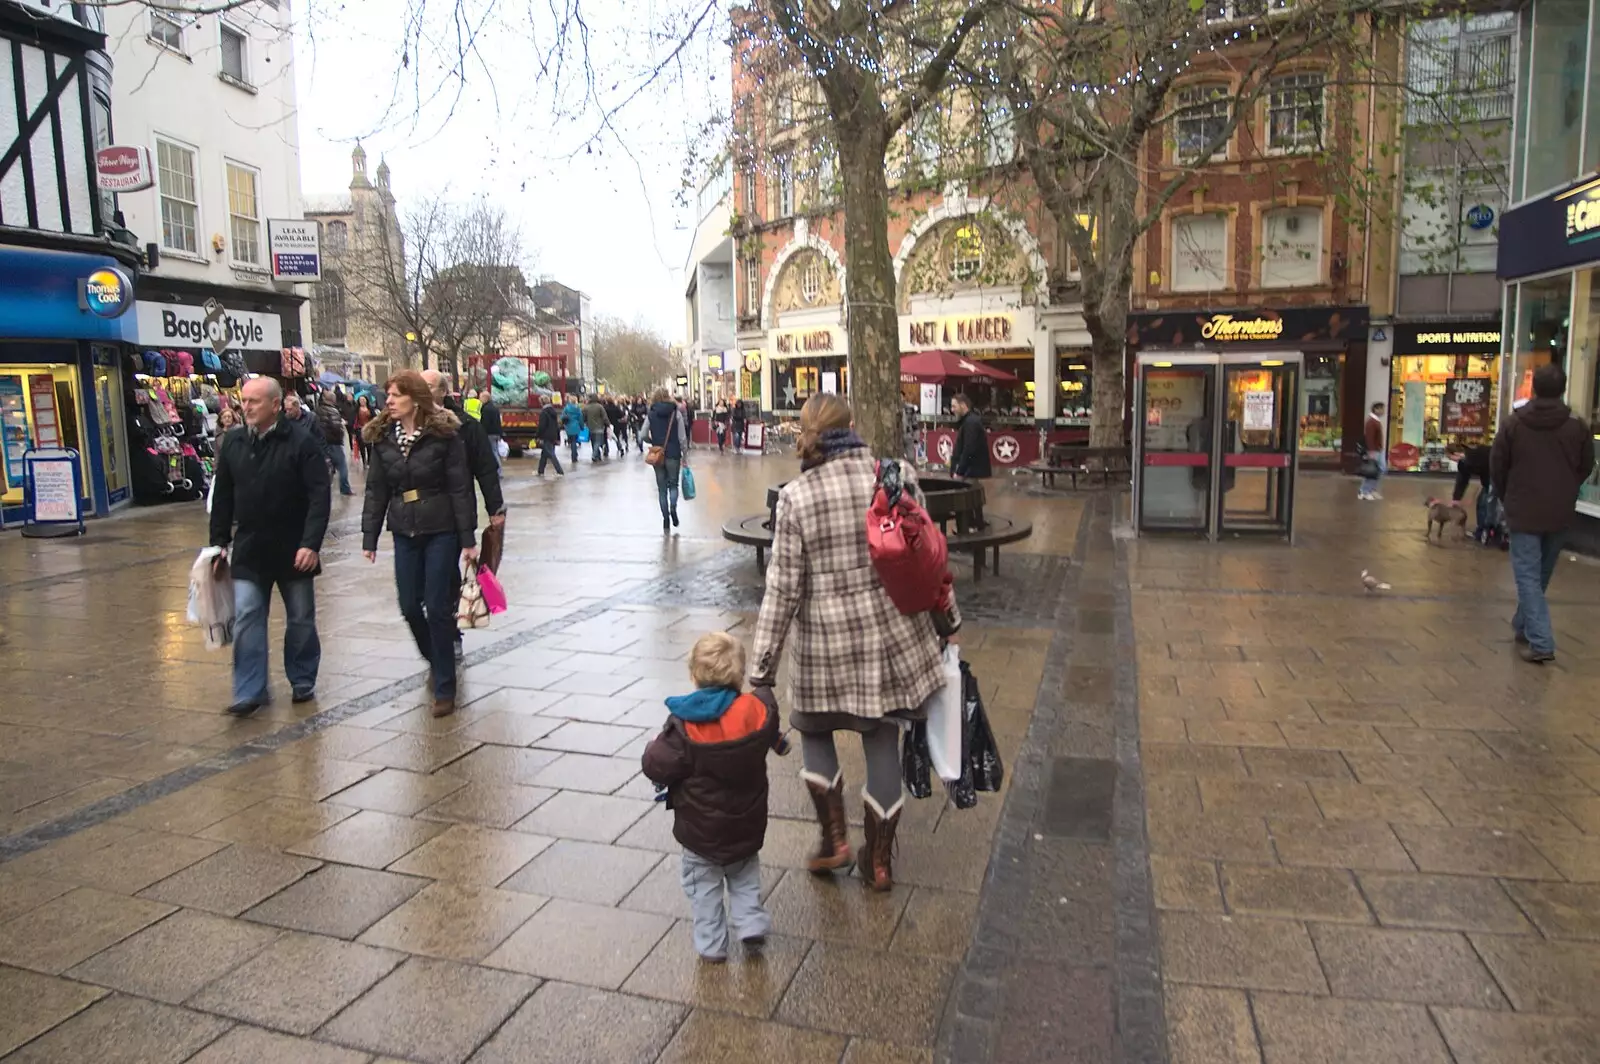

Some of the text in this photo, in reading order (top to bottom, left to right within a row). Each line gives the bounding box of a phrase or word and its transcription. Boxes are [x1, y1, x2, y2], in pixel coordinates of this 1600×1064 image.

[100, 173, 142, 188] RESTAURANT
[87, 284, 120, 294] Thomas
[98, 292, 120, 304] Cook
[208, 315, 230, 341] of
[909, 315, 1011, 345] PRET A MANGER
[1202, 314, 1283, 338] Thorntons
[1417, 332, 1500, 343] SPORTS NUTRITION
[1453, 380, 1484, 394] 40%
